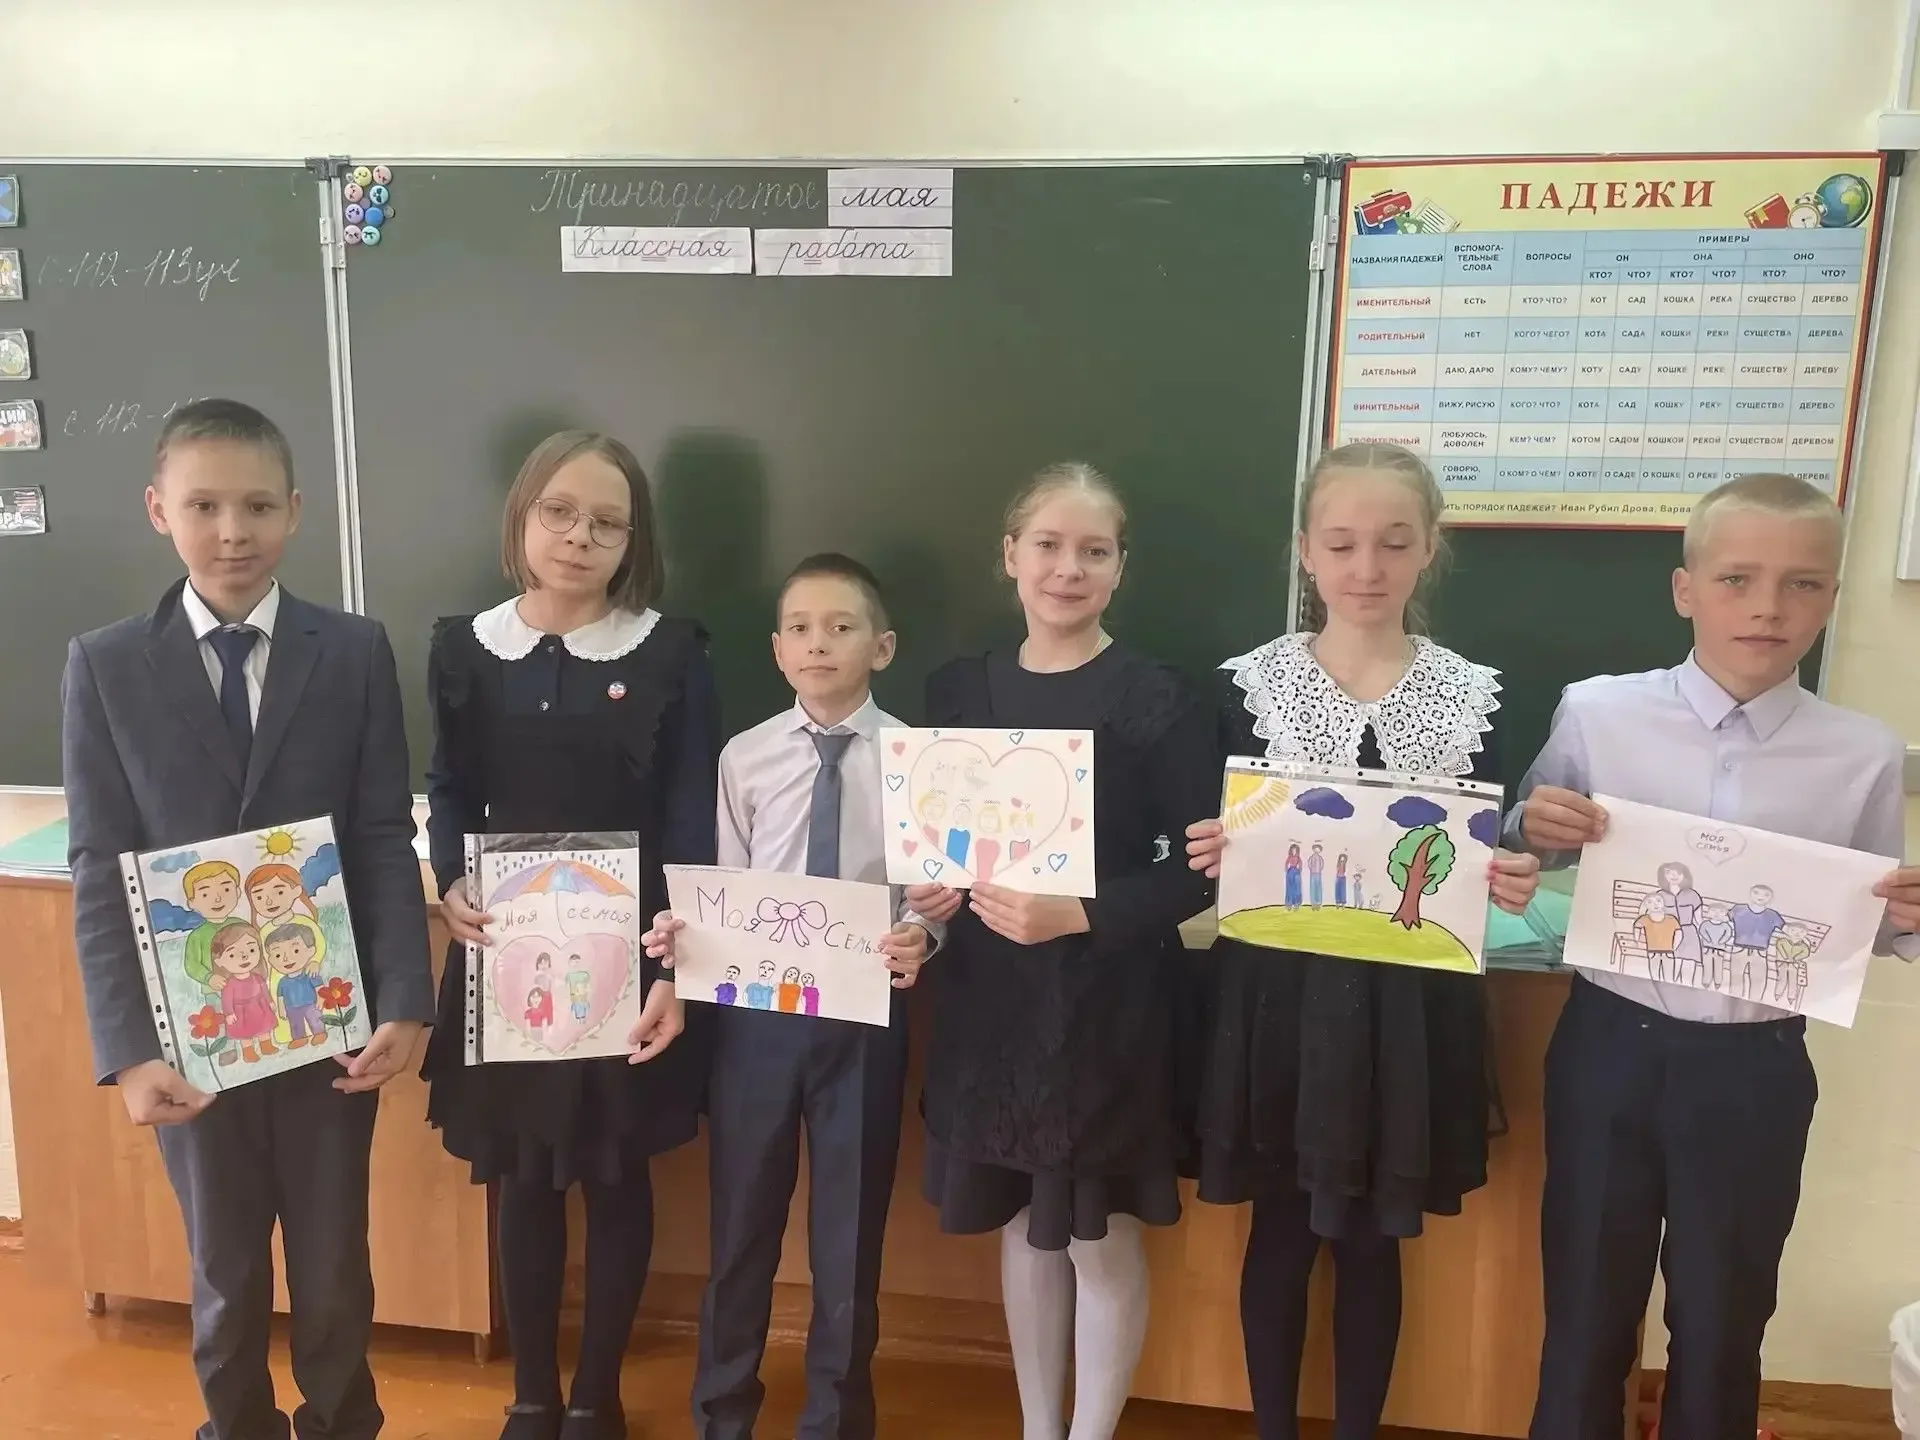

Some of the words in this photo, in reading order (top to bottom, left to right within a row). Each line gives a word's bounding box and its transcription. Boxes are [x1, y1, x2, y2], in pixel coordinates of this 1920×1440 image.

[841, 187, 939, 208] мая
[1500, 180, 1716, 216] ПАДЕЖИ
[1698, 235, 1750, 243] ПРИМЕРЫ
[573, 225, 733, 259] Классная
[777, 228, 915, 276] работа
[1454, 244, 1504, 253] ВСПОМОГА-
[1352, 256, 1399, 265] НАЗВАНИЯ
[1400, 254, 1443, 264] ПАДЕЖЕЙ
[1457, 254, 1499, 262] ТЕЛЬНЫЕ
[1525, 253, 1572, 261] ВОПРОСЫ
[1616, 254, 1629, 262] ОН
[1693, 253, 1713, 261] ОНА
[1793, 253, 1815, 261] ОНО
[1462, 263, 1492, 271] СЛОВА
[1712, 270, 1736, 278] ЧТО?
[1762, 270, 1786, 278] КТО?
[1821, 270, 1846, 278] ЧТО?
[1357, 296, 1431, 306] ИМЕНИТЕЛЬНЫЙ
[1464, 297, 1486, 305] ЕСТЬ
[1522, 296, 1543, 304] КТО?
[1544, 296, 1567, 304] ЧТО?
[1590, 296, 1607, 304] КОТ
[1628, 296, 1646, 304] САД
[1663, 296, 1694, 304] КОШКА
[1710, 296, 1732, 304] РЕКА
[1747, 295, 1796, 304] СУЩЕСТВО
[1812, 295, 1849, 304] ДЕРЕВО
[1358, 332, 1425, 341] РОДИТЕЛЬНЫЙ
[1514, 330, 1541, 338] КОГО?
[1543, 330, 1570, 338] ЧЕГО?
[1585, 330, 1606, 338] КОТА
[1622, 330, 1646, 338] САДА
[1660, 330, 1691, 338] КОШКИ
[1744, 329, 1792, 338] СУЩЕСТВА
[1808, 329, 1844, 338] ДЕРЕВА
[1361, 367, 1417, 376] ДАТЕЛЬНЫЙ
[1445, 366, 1467, 375] ДАЮ,
[1469, 366, 1494, 374] ДАРЮ
[1510, 366, 1538, 374] КОМУ?
[1540, 366, 1568, 374] ЧЕМУ?
[1581, 366, 1604, 374] КОТУ
[1618, 366, 1642, 374] САДУ
[1657, 366, 1687, 374] КОШКЕ
[1702, 366, 1725, 374] РЕКЕ
[1740, 366, 1788, 374] СУЩЕСТВУ
[1804, 366, 1840, 375] ДЕРЕВУ
[1353, 402, 1420, 412] ВИНИТЕЛЬНЫЙ
[1438, 401, 1464, 410] ВИЖУ,
[1465, 400, 1496, 408] РИСУЮ
[1618, 401, 1636, 410] САД
[1654, 401, 1684, 409] КОШКУ
[1700, 401, 1722, 409] РЕКУ
[1736, 401, 1785, 410] СУЩЕСТВО
[1799, 402, 1835, 410] ДЕРЕВО
[1441, 431, 1488, 439] ЛЮБУЮСЬ,
[1443, 440, 1485, 448] ДОВОЛЕН
[1572, 436, 1600, 444] КОТОМ
[1608, 436, 1640, 445] САДОМ
[1648, 436, 1684, 444] КОШКОЙ
[1692, 436, 1721, 444] РЕКОЙ
[1728, 436, 1784, 446] СУЩЕСТВОМ
[1792, 437, 1834, 446] ДЕРЕВОМ
[1442, 465, 1480, 474] ГОВОРЮ,
[1445, 474, 1477, 482] ДУМАЮ
[1613, 471, 1636, 479] САДЕ
[1463, 504, 1505, 512] ПОРЯДОК
[1506, 504, 1556, 513] ПАДЕЖЕЙ?
[1561, 504, 1586, 512] Иван
[1588, 504, 1620, 515] Рубил
[1622, 504, 1657, 514] Дрова,
[1660, 504, 1691, 514] Варва
[697, 886, 761, 933] Моя
[499, 909, 538, 932] Моя
